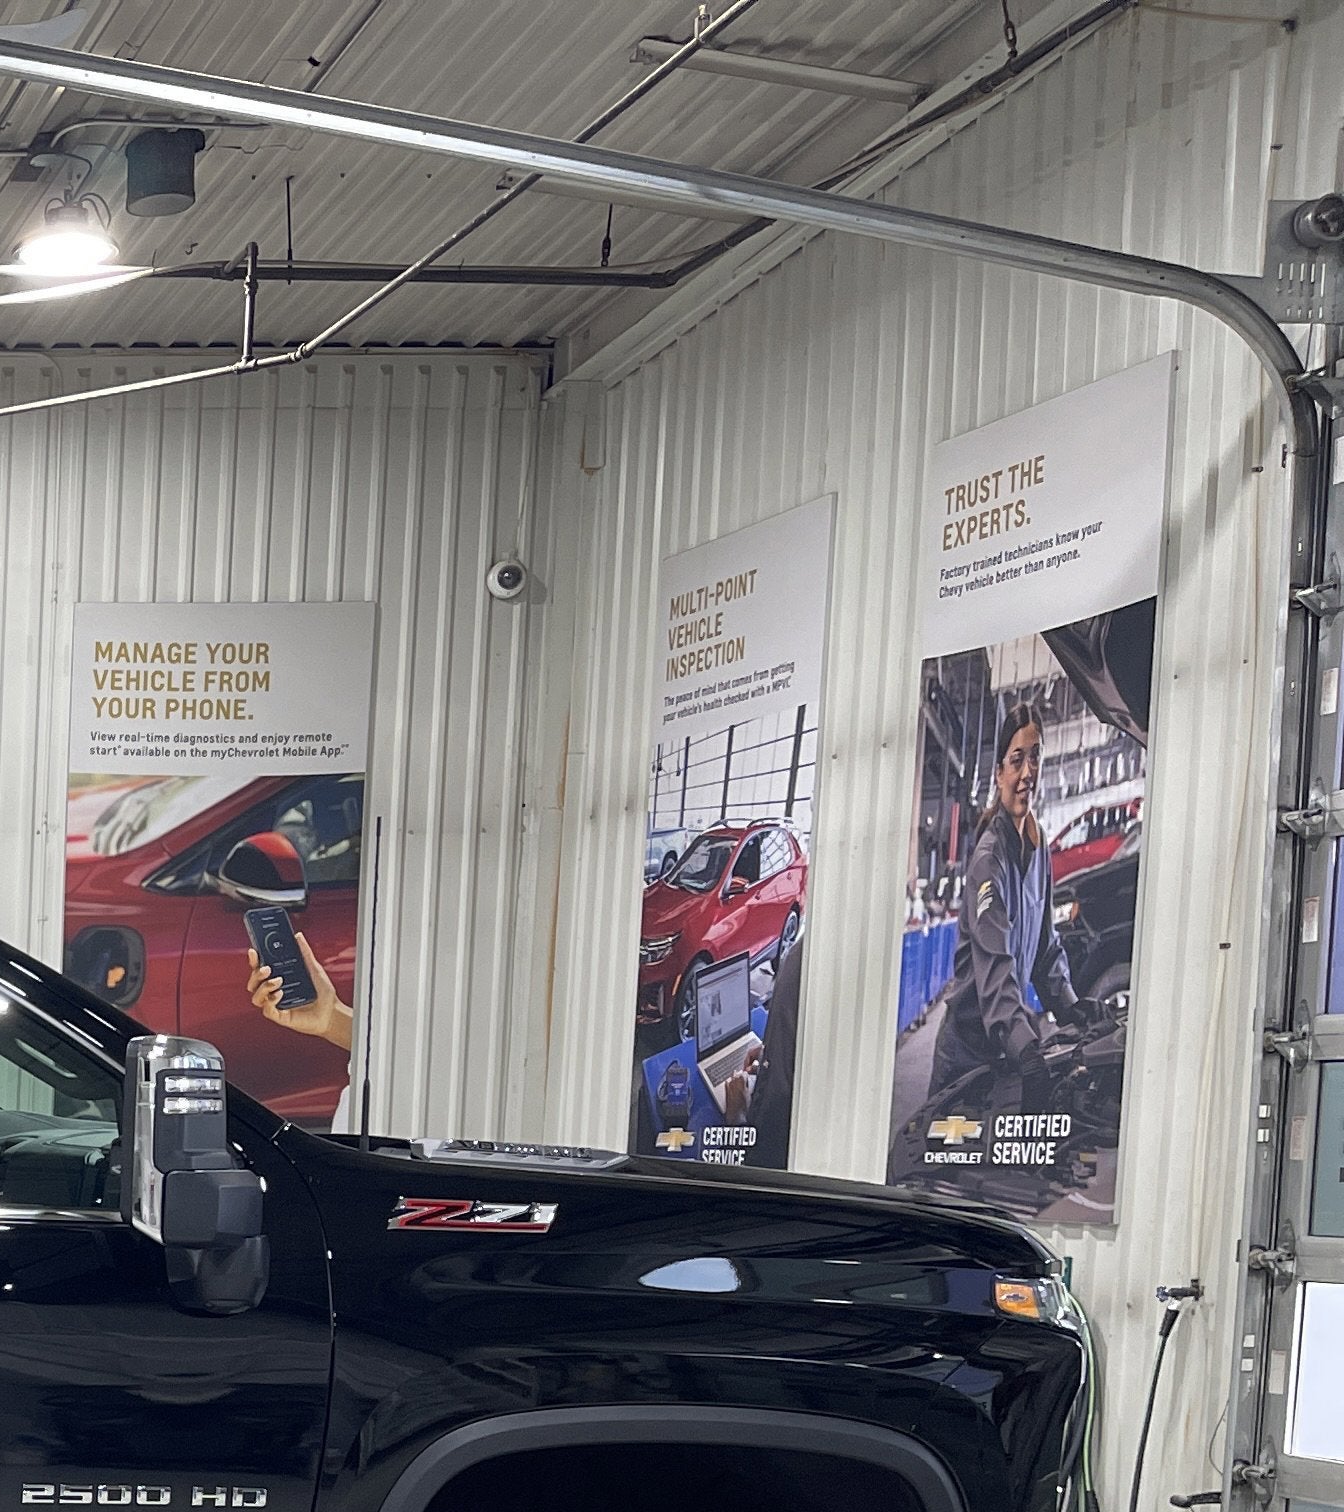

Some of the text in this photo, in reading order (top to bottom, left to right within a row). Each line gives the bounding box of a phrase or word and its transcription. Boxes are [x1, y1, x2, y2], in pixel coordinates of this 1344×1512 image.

[944, 455, 1046, 516] TRUST THE
[942, 498, 1031, 552] EXPERTS.
[940, 520, 1103, 582] Factory trained technicians know your
[939, 548, 1081, 599] Chevy vehicle better than anyone.
[669, 569, 758, 621] MULTI-POINT
[668, 612, 724, 651] VEHICLE
[94, 641, 270, 665] MANAGE YOUR
[665, 635, 746, 682] INSPECTION
[92, 669, 271, 693] VEHICLE FROM
[664, 695, 674, 707] The
[694, 687, 701, 699] of
[753, 669, 769, 682] from
[91, 696, 254, 721] YOUR PHONE.
[90, 731, 333, 746] View real-time diagnostics and enjoy remote
[123, 745, 171, 757] available
[174, 748, 187, 757] on
[190, 747, 208, 758] the
[210, 747, 280, 760] myChevrolet
[282, 745, 317, 757] Mobile
[702, 1126, 757, 1147] CERTIFIED
[994, 1113, 1071, 1138] CERTIFIED
[701, 1149, 746, 1167] SERVICE
[924, 1141, 1057, 1165] CHEVROLET SERVICE
[386, 1195, 560, 1234] Z71
[21, 1483, 268, 1508] 2500 HD
